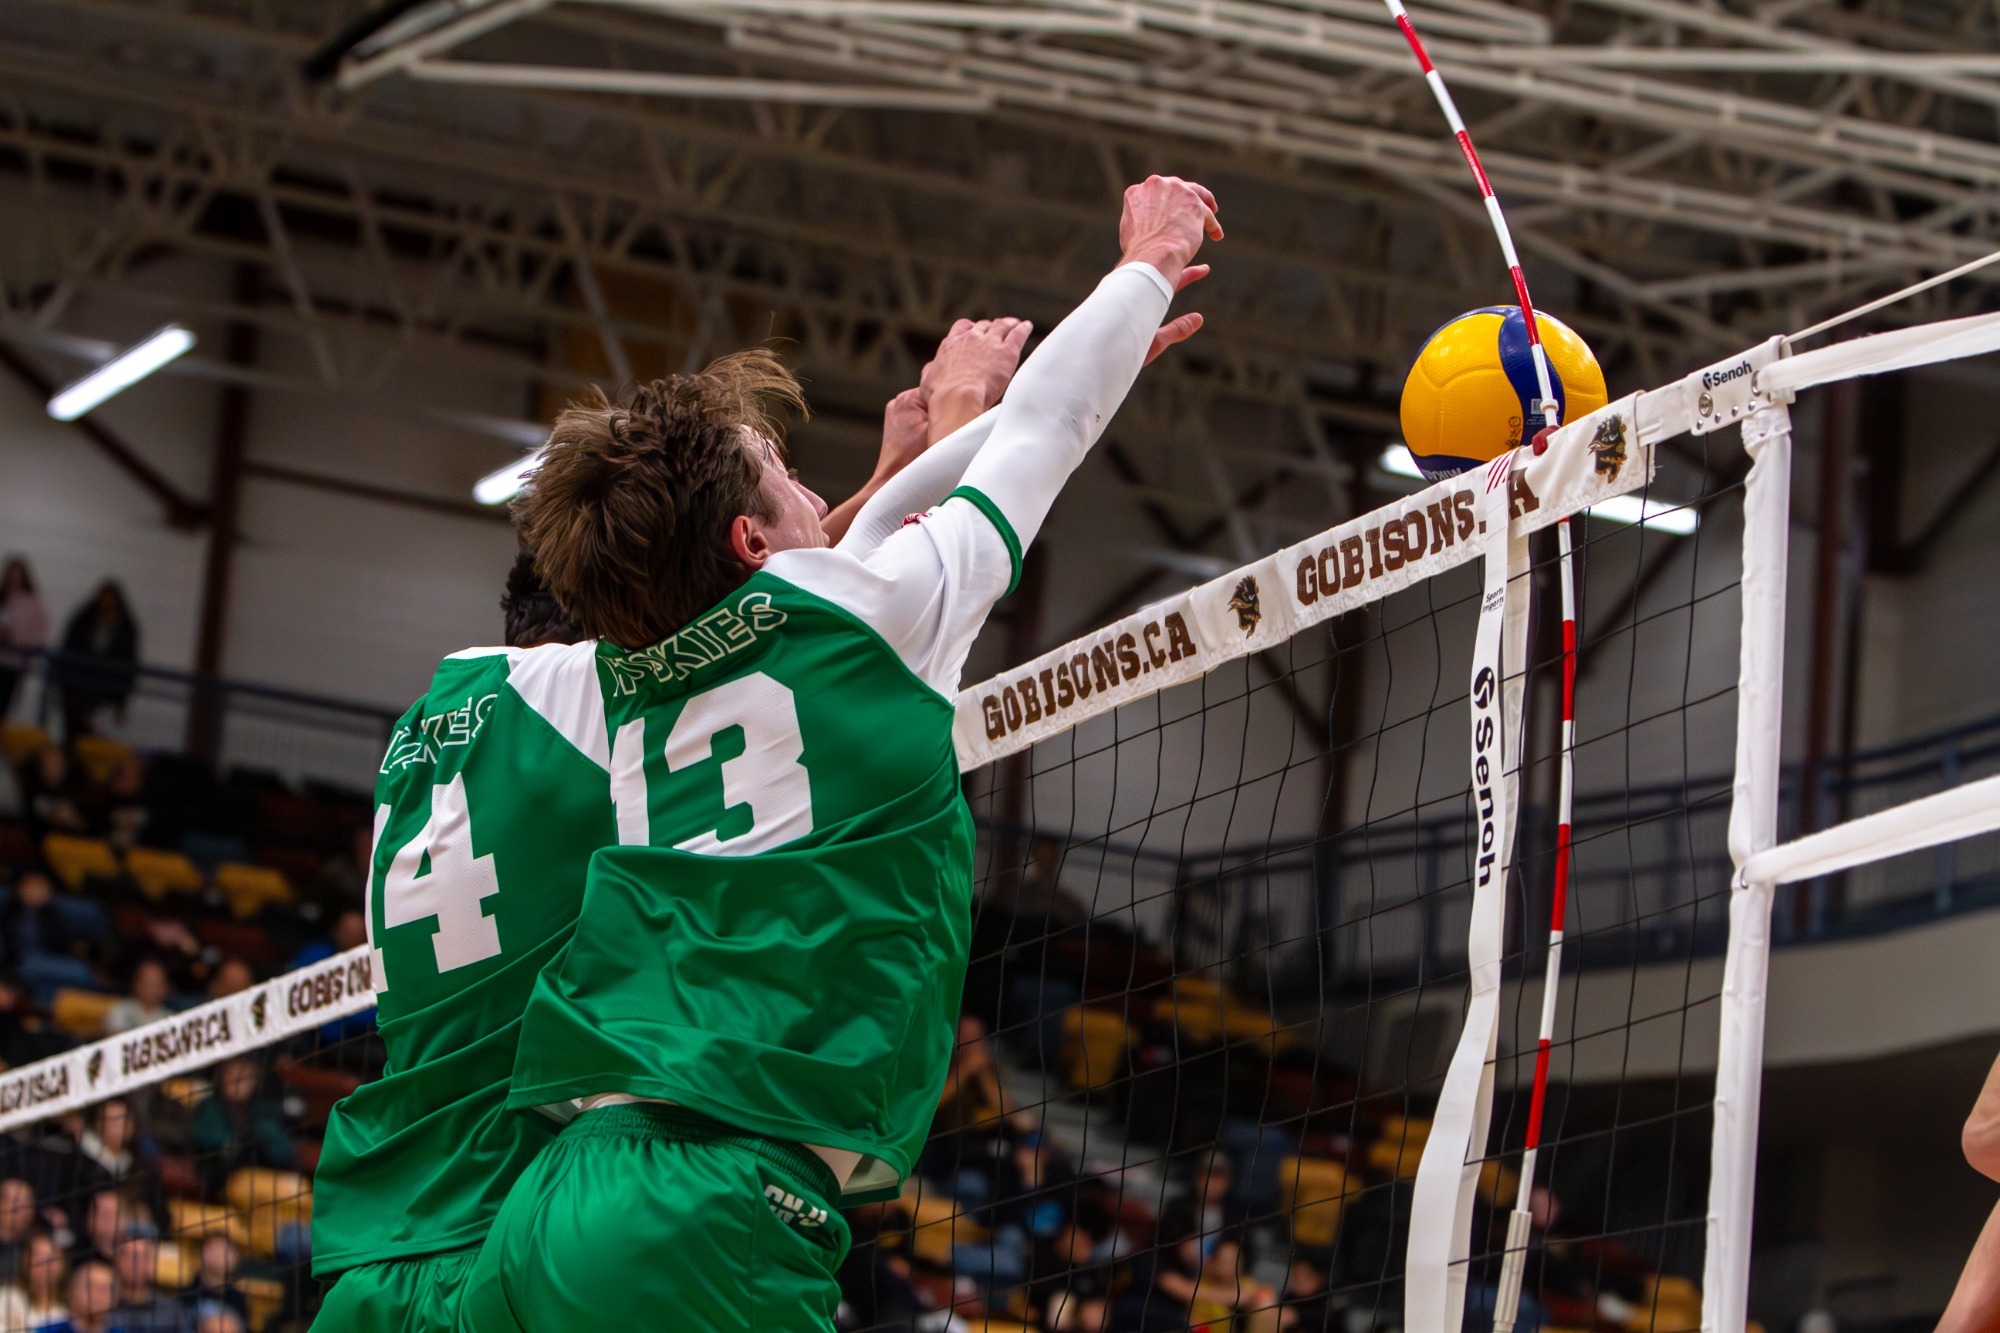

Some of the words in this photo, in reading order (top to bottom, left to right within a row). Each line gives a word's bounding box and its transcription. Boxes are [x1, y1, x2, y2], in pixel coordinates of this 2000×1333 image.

[1713, 361, 1752, 387] Senoh
[1297, 467, 1540, 606] GOBISONS.A
[981, 611, 1197, 741] GOBISONS.CA
[610, 670, 814, 857] 13
[1475, 716, 1496, 887] Senoh
